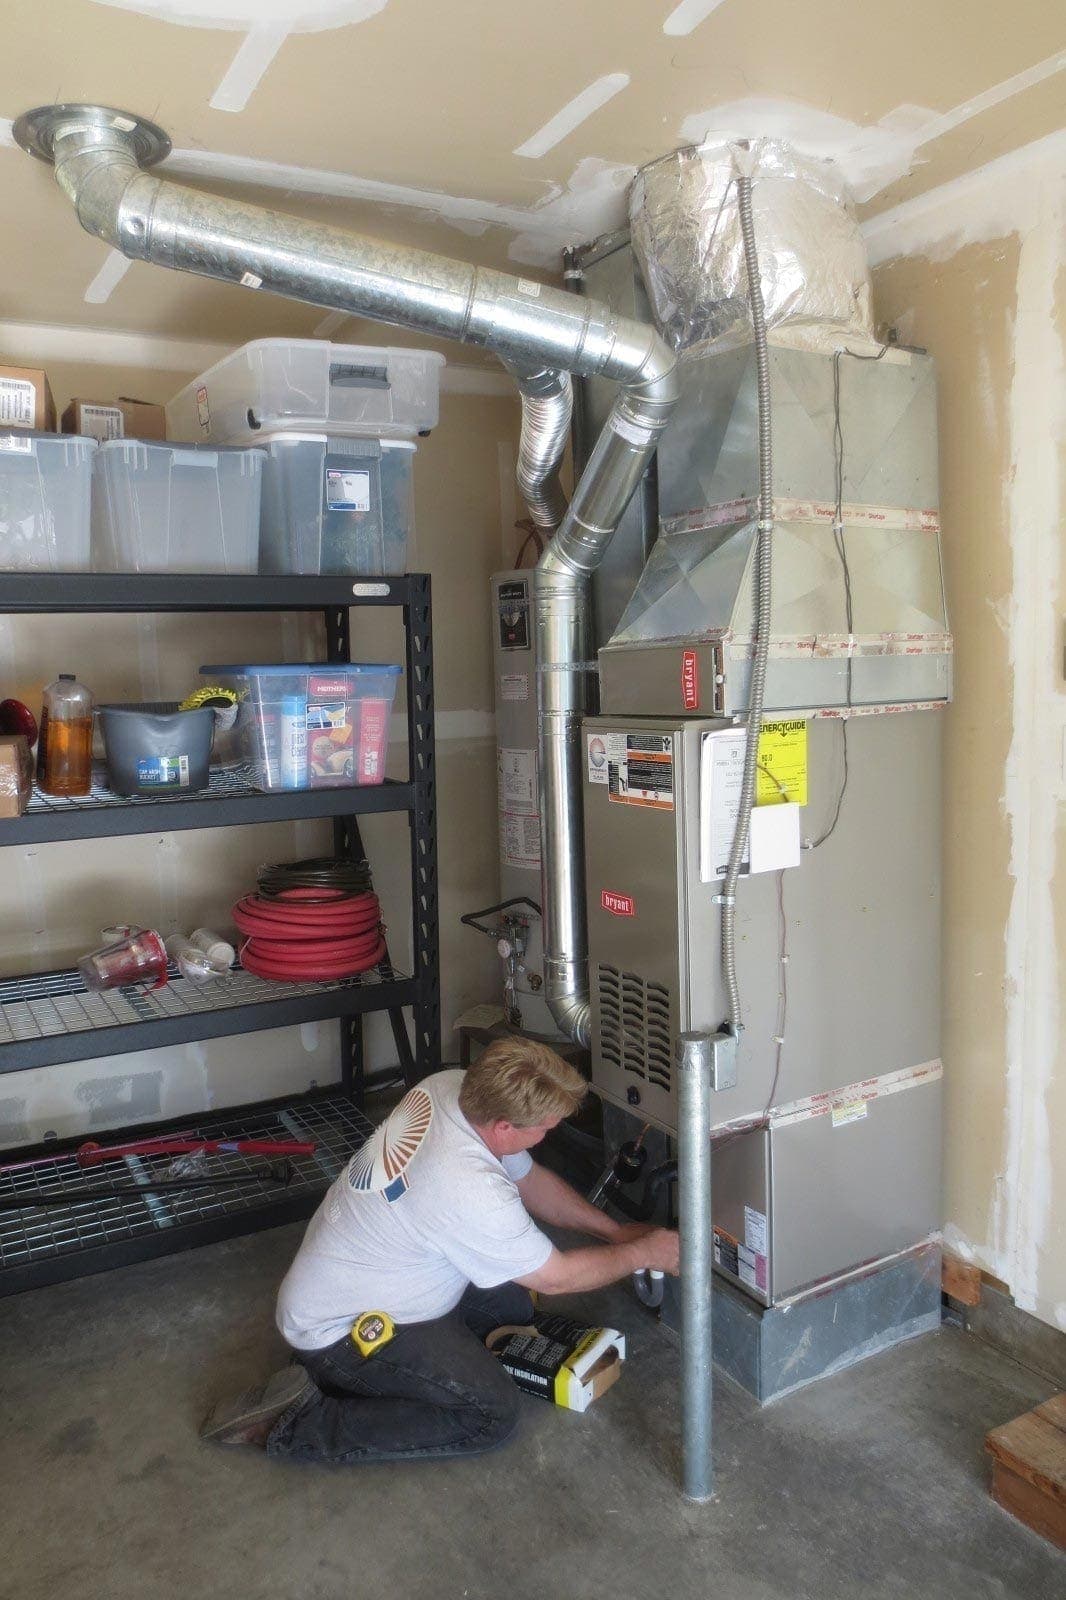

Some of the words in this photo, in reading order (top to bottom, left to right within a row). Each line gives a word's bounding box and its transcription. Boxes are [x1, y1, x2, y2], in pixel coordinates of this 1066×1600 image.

[684, 659, 694, 701] bryant
[605, 894, 629, 912] bryant
[514, 1368, 548, 1385] INSULATION
